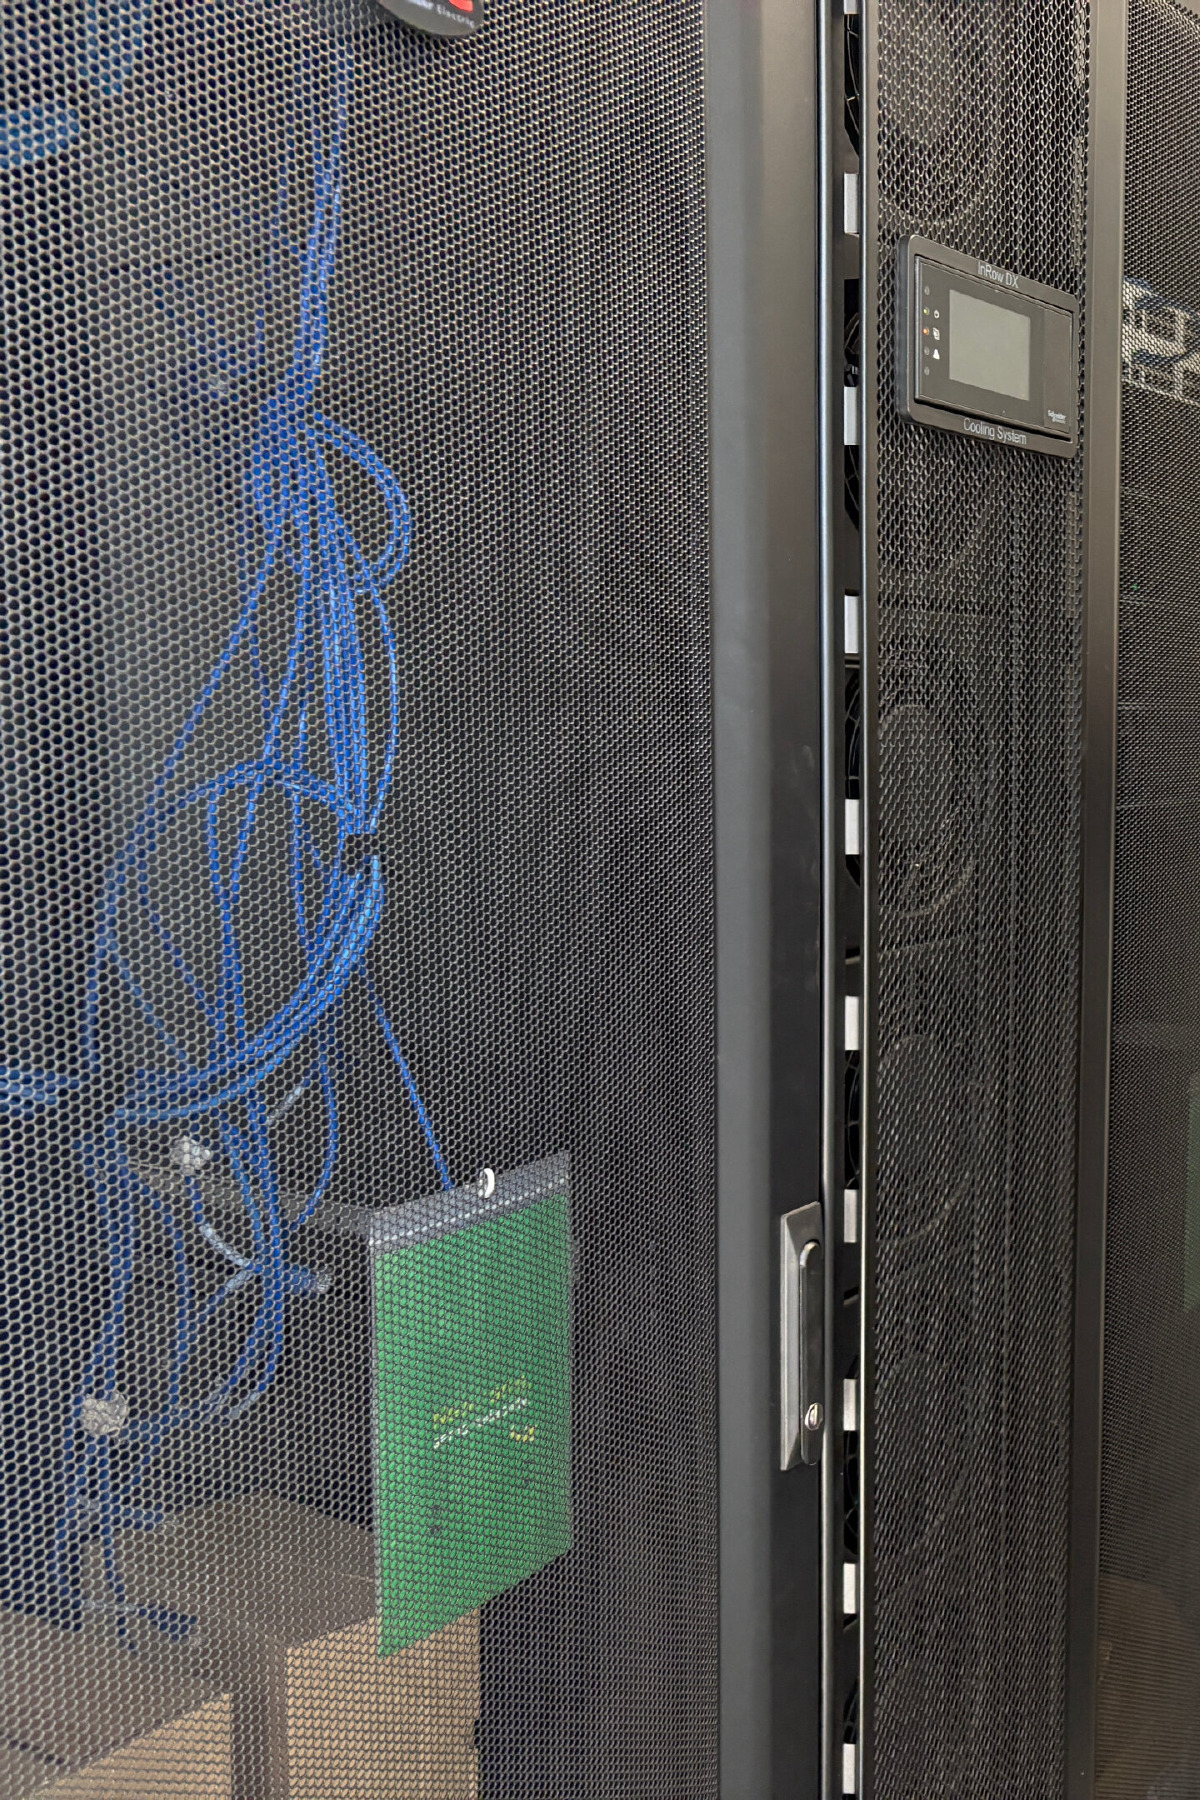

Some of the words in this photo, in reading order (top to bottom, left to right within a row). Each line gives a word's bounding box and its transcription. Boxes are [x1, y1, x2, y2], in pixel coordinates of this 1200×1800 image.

[978, 260, 1004, 283] InRow
[1006, 272, 1019, 289] DX
[963, 417, 995, 440] Cooling
[997, 425, 1027, 444] System
